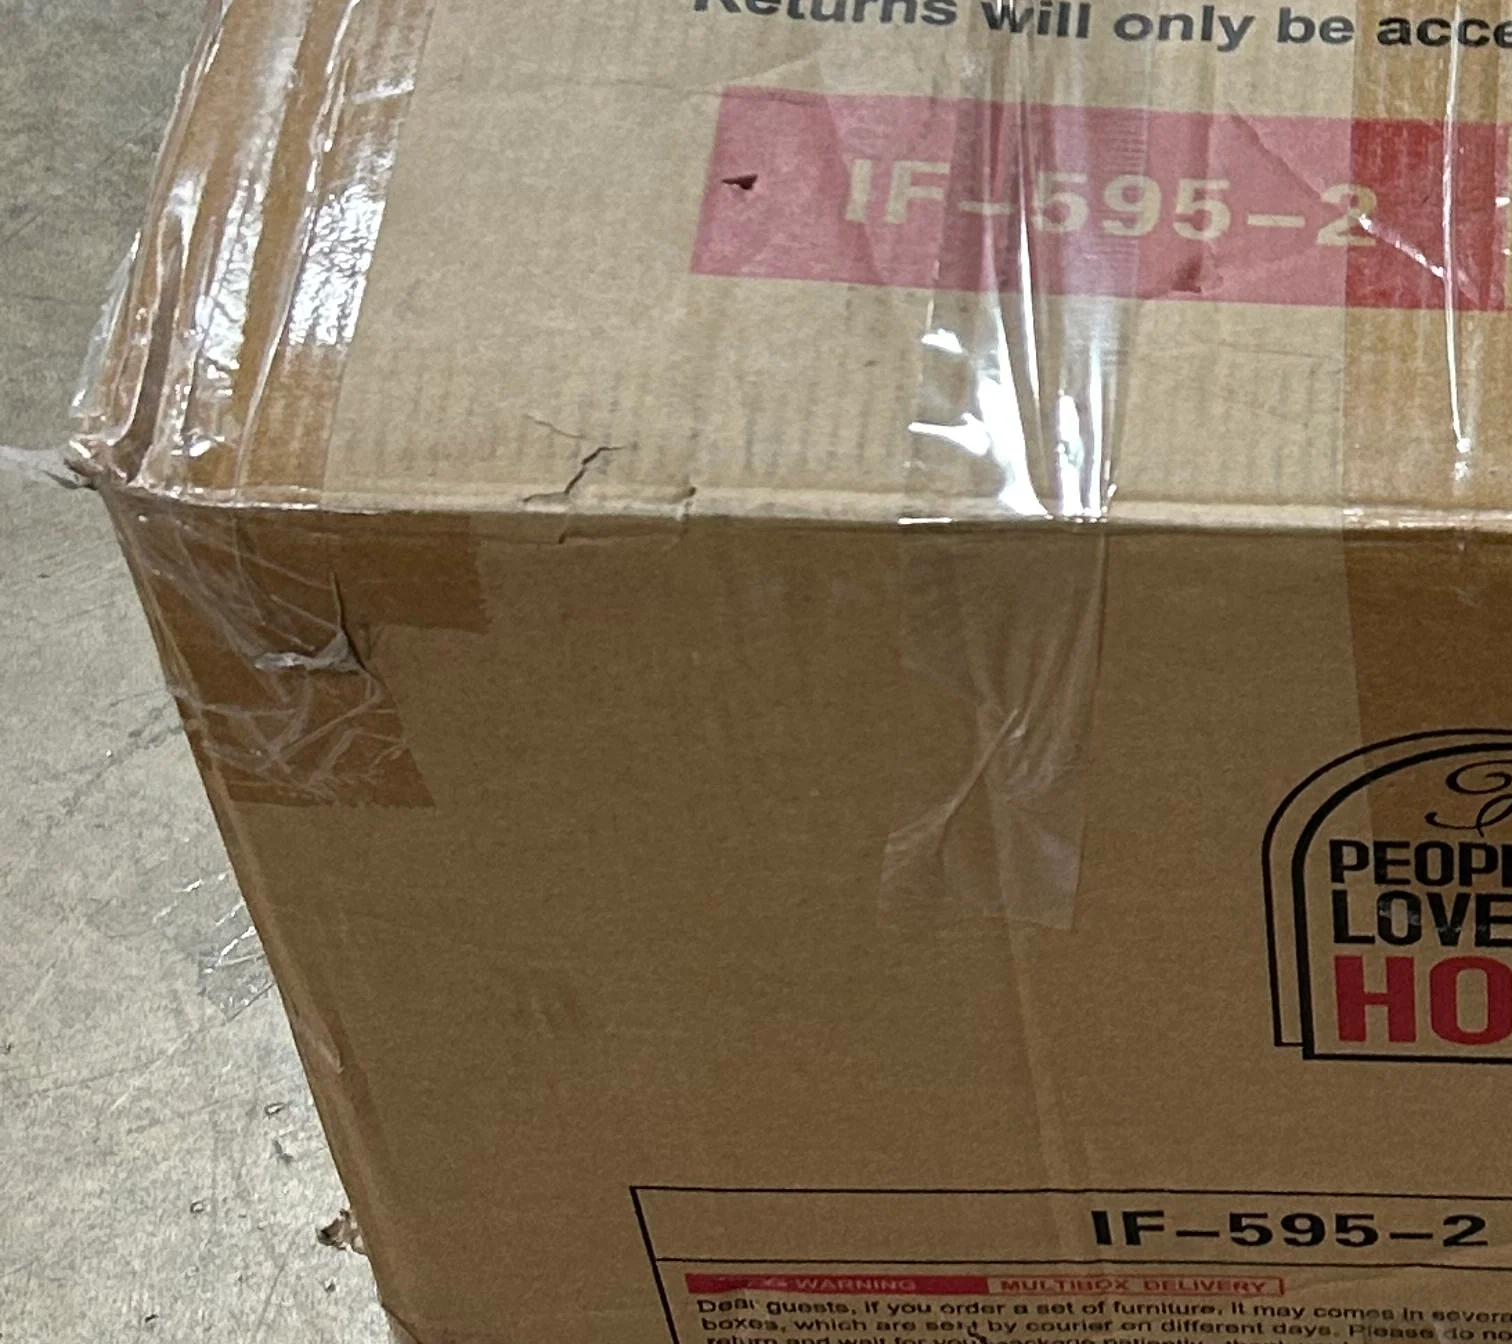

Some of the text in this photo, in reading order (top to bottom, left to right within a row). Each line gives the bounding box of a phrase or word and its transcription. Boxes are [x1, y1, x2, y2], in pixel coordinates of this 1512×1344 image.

[1113, 7, 1255, 53] only
[1277, 7, 1355, 47] be
[845, 159, 1378, 248] IF-595-2
[1091, 1209, 1488, 1248] IF-595-2
[795, 1278, 916, 1291] WARNING
[1001, 1279, 1266, 1294] MULTIBOX DELIVERY
[697, 1299, 756, 1314] Dear
[766, 1301, 857, 1316] guests,
[888, 1303, 931, 1317] you
[940, 1302, 1004, 1315] order
[1013, 1304, 1028, 1315] a
[1037, 1303, 1073, 1315] set
[1082, 1301, 1105, 1315] of
[1114, 1301, 1224, 1316] furniture,
[1254, 1305, 1305, 1320] may
[1314, 1307, 1394, 1320] comes
[1403, 1307, 1423, 1321] in
[702, 1317, 786, 1332] boxes,
[794, 1318, 867, 1331] which
[876, 1320, 916, 1331] are
[988, 1320, 1017, 1333] by
[1026, 1320, 1112, 1332] courier
[1120, 1321, 1152, 1332] on
[1161, 1319, 1264, 1335] different
[1272, 1323, 1339, 1338] days.
[1349, 1325, 1435, 1339] Please
[1443, 1326, 1475, 1340] do
